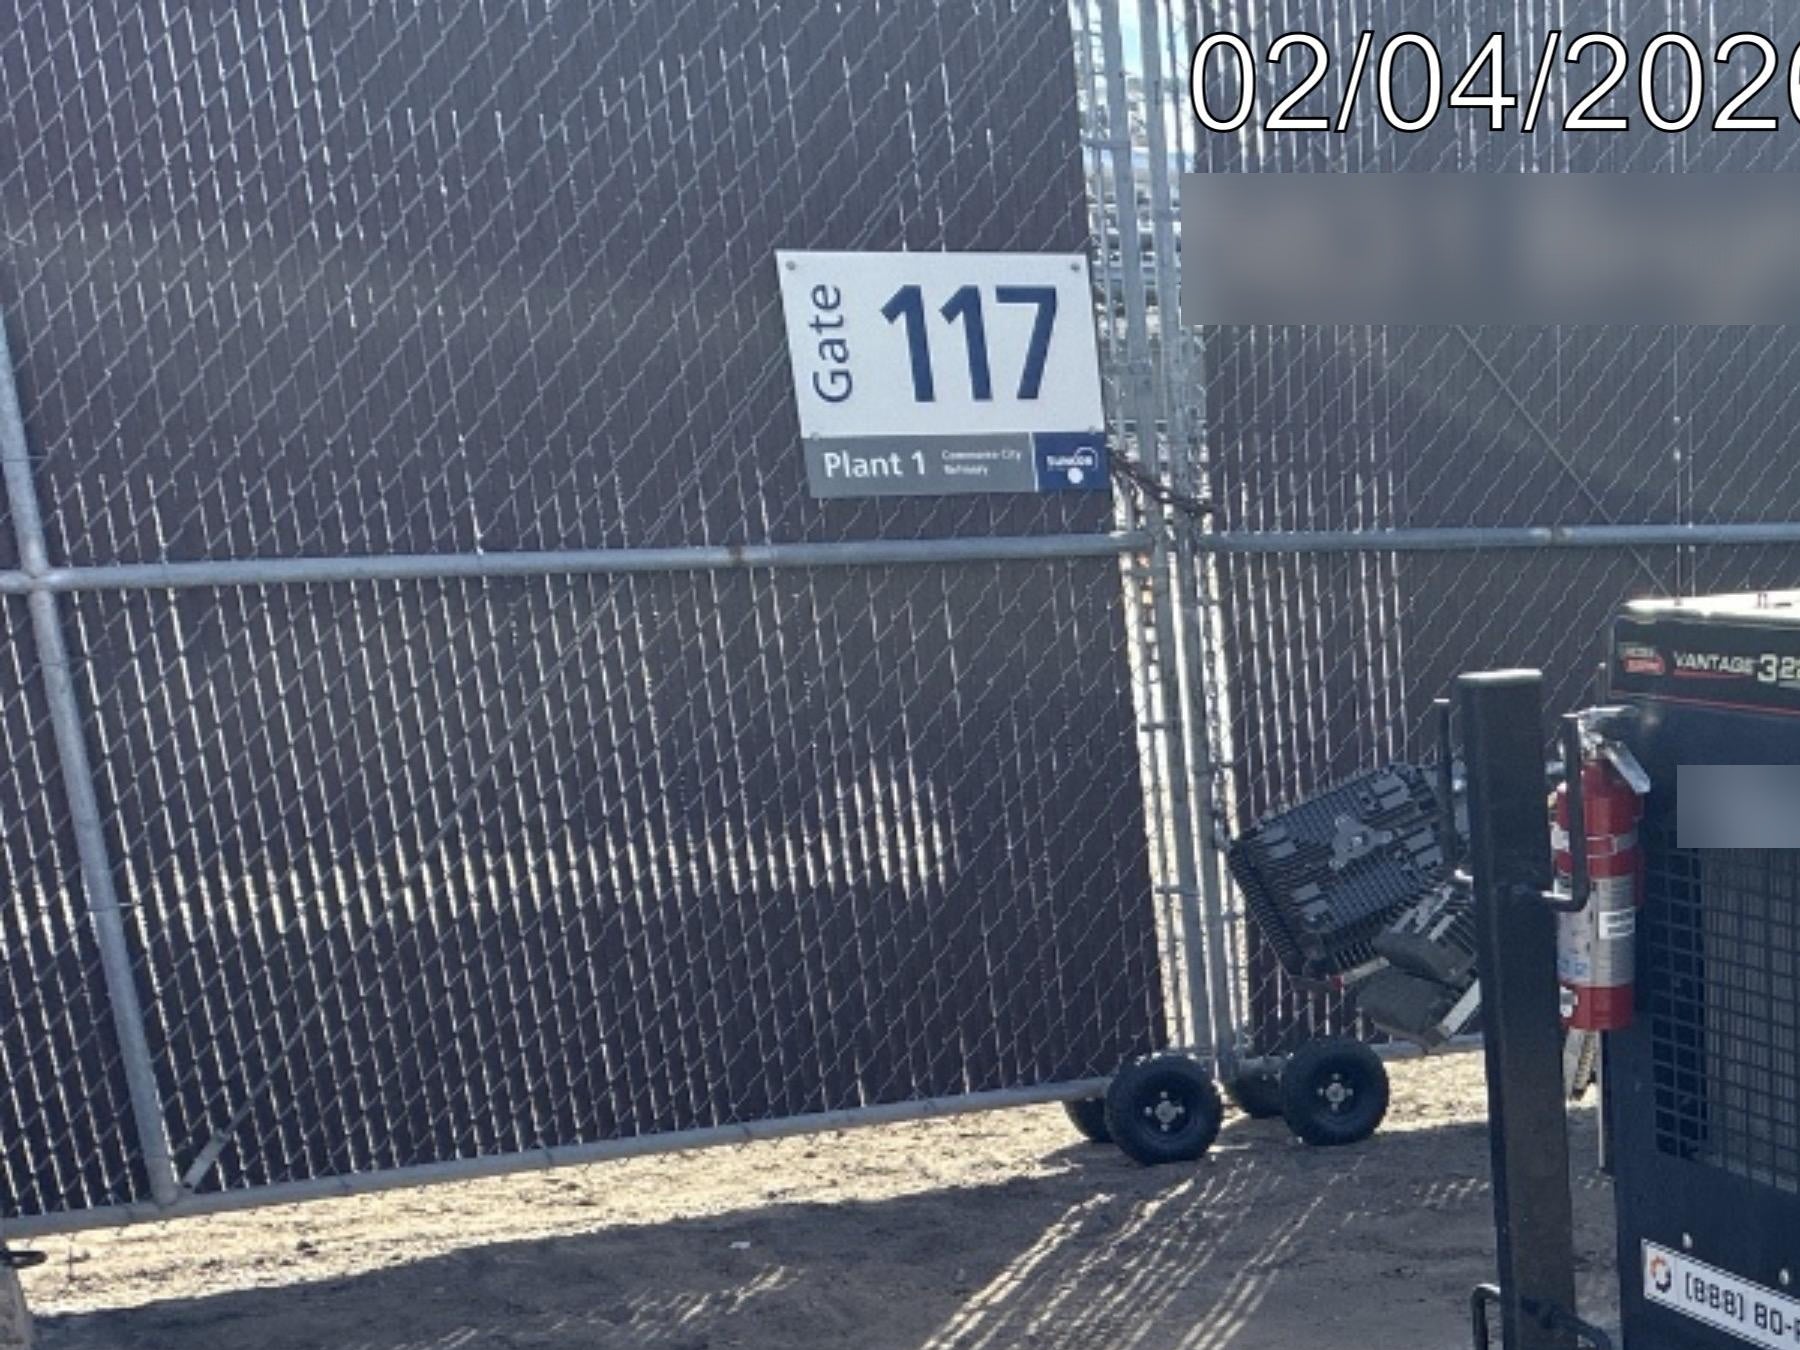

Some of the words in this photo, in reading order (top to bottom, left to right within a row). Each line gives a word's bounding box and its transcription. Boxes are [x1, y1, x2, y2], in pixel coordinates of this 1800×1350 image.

[808, 284, 853, 402] Gate
[880, 284, 1058, 402] 117
[823, 452, 904, 478] Plant
[911, 450, 925, 475] 1
